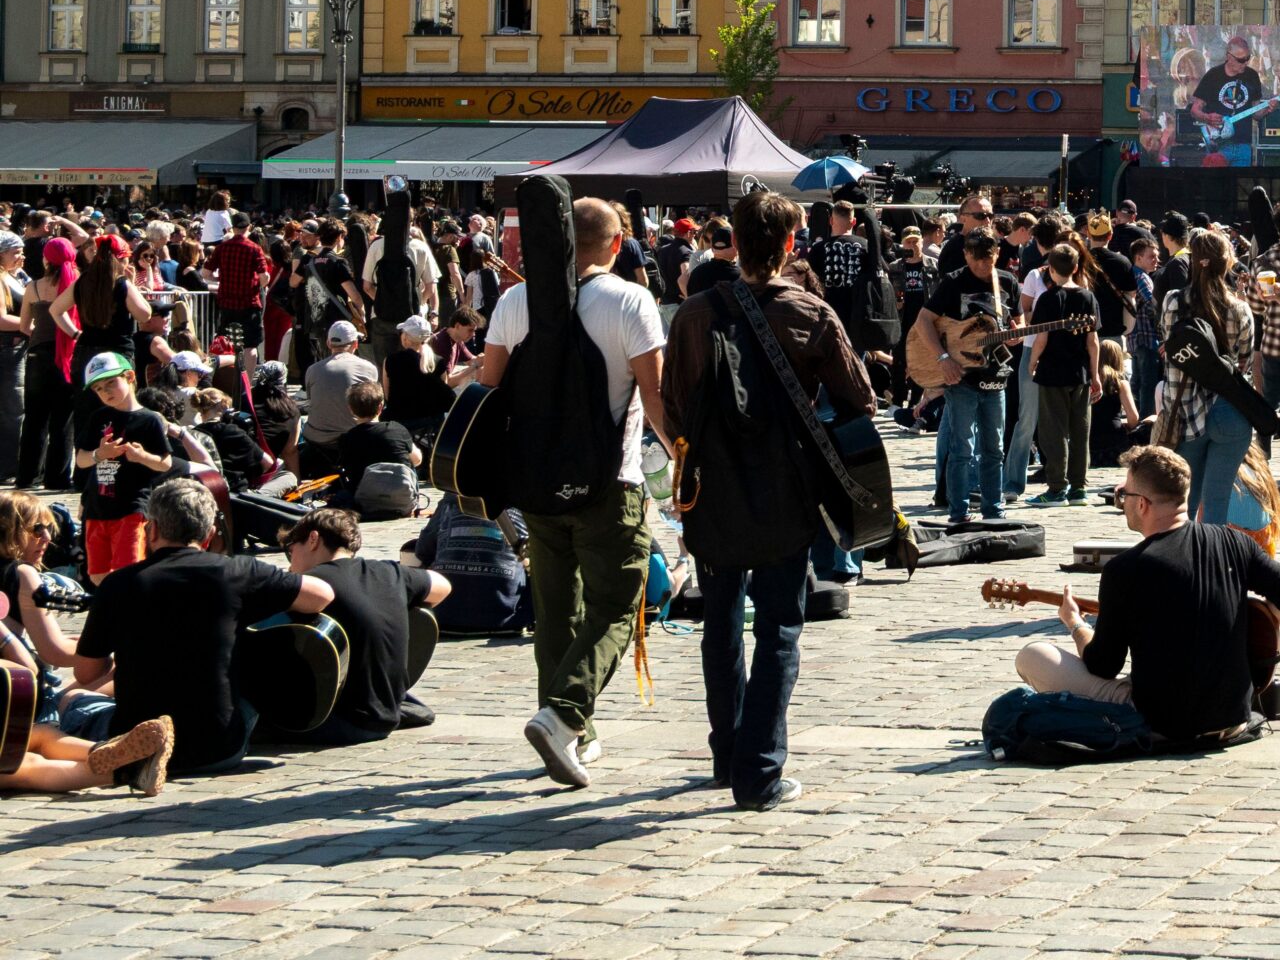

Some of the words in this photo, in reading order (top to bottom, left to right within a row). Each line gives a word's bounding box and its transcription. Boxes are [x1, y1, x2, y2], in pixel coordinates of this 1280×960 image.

[103, 96, 140, 110] ENIGMA
[376, 97, 446, 109] RISTORANTE
[518, 90, 574, 117] Sole
[576, 89, 634, 116] Mio
[856, 86, 1064, 113] GRECO
[446, 166, 470, 178] Sole
